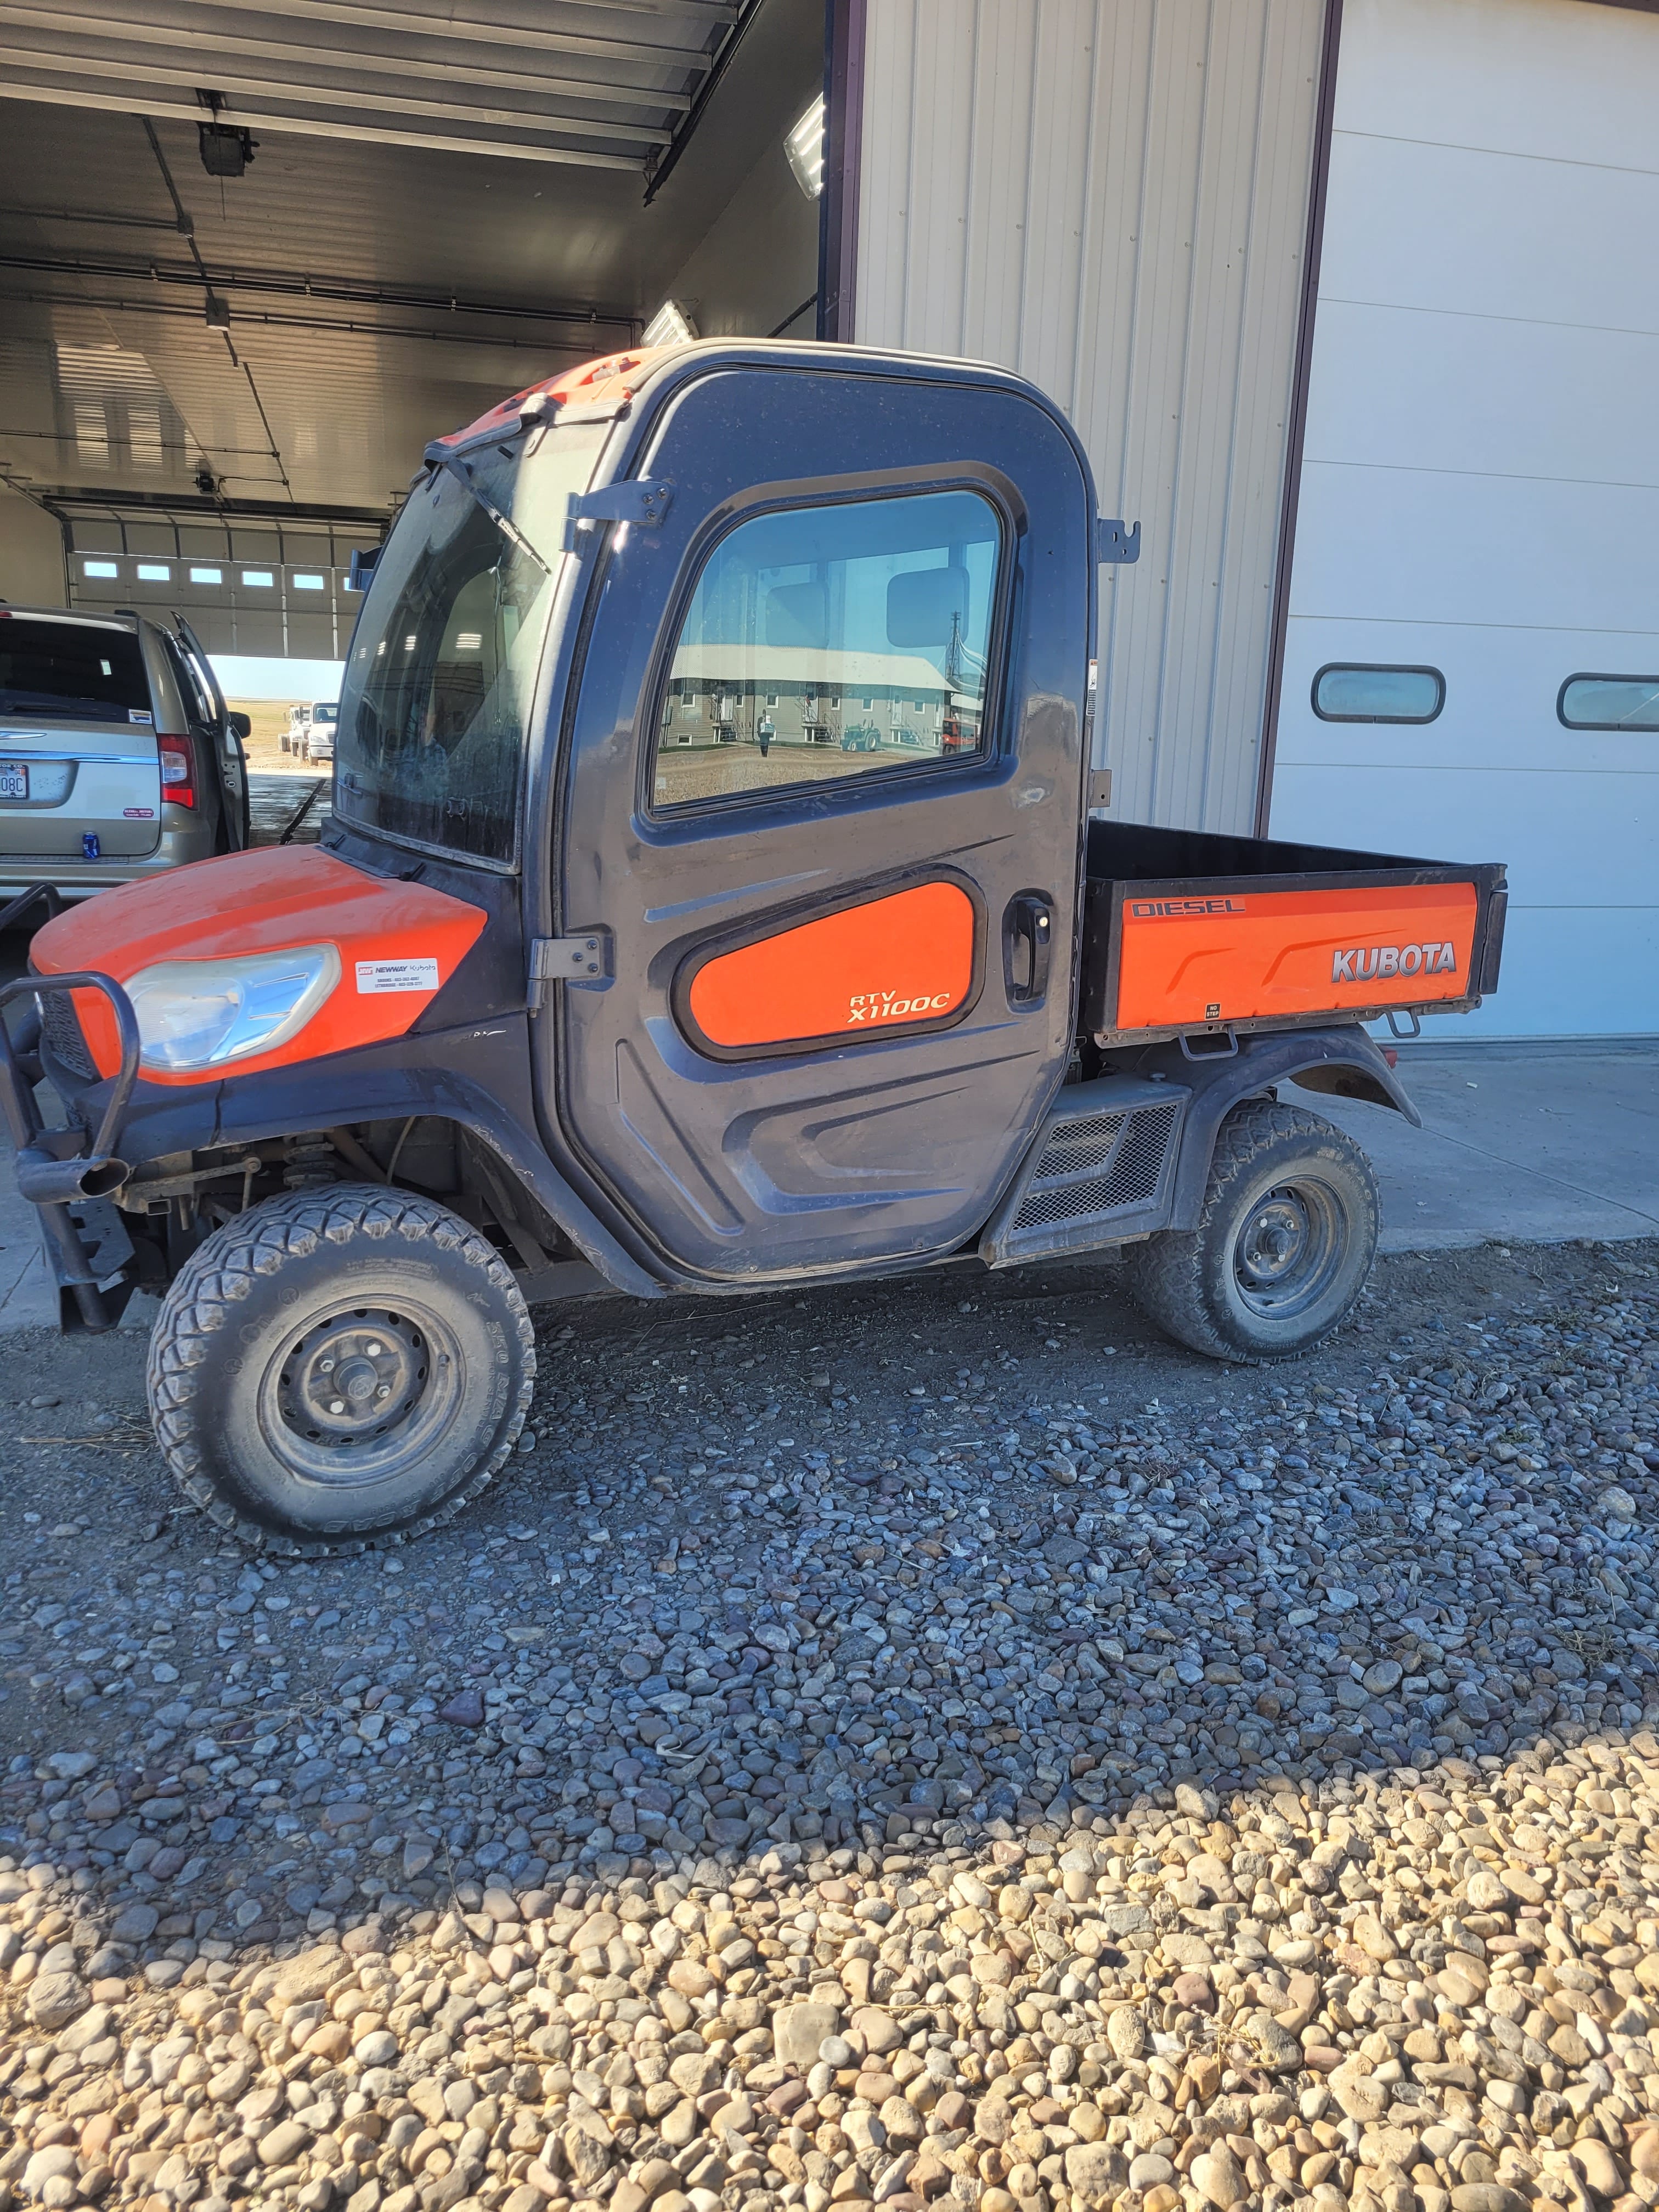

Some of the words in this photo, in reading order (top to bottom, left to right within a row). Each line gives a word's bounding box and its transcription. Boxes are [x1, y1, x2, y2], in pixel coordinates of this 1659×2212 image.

[1132, 899, 1245, 917] DIESEL
[1331, 941, 1456, 983] KUBOTA
[847, 992, 950, 1023] X1100C
[850, 990, 896, 1007] RTV
